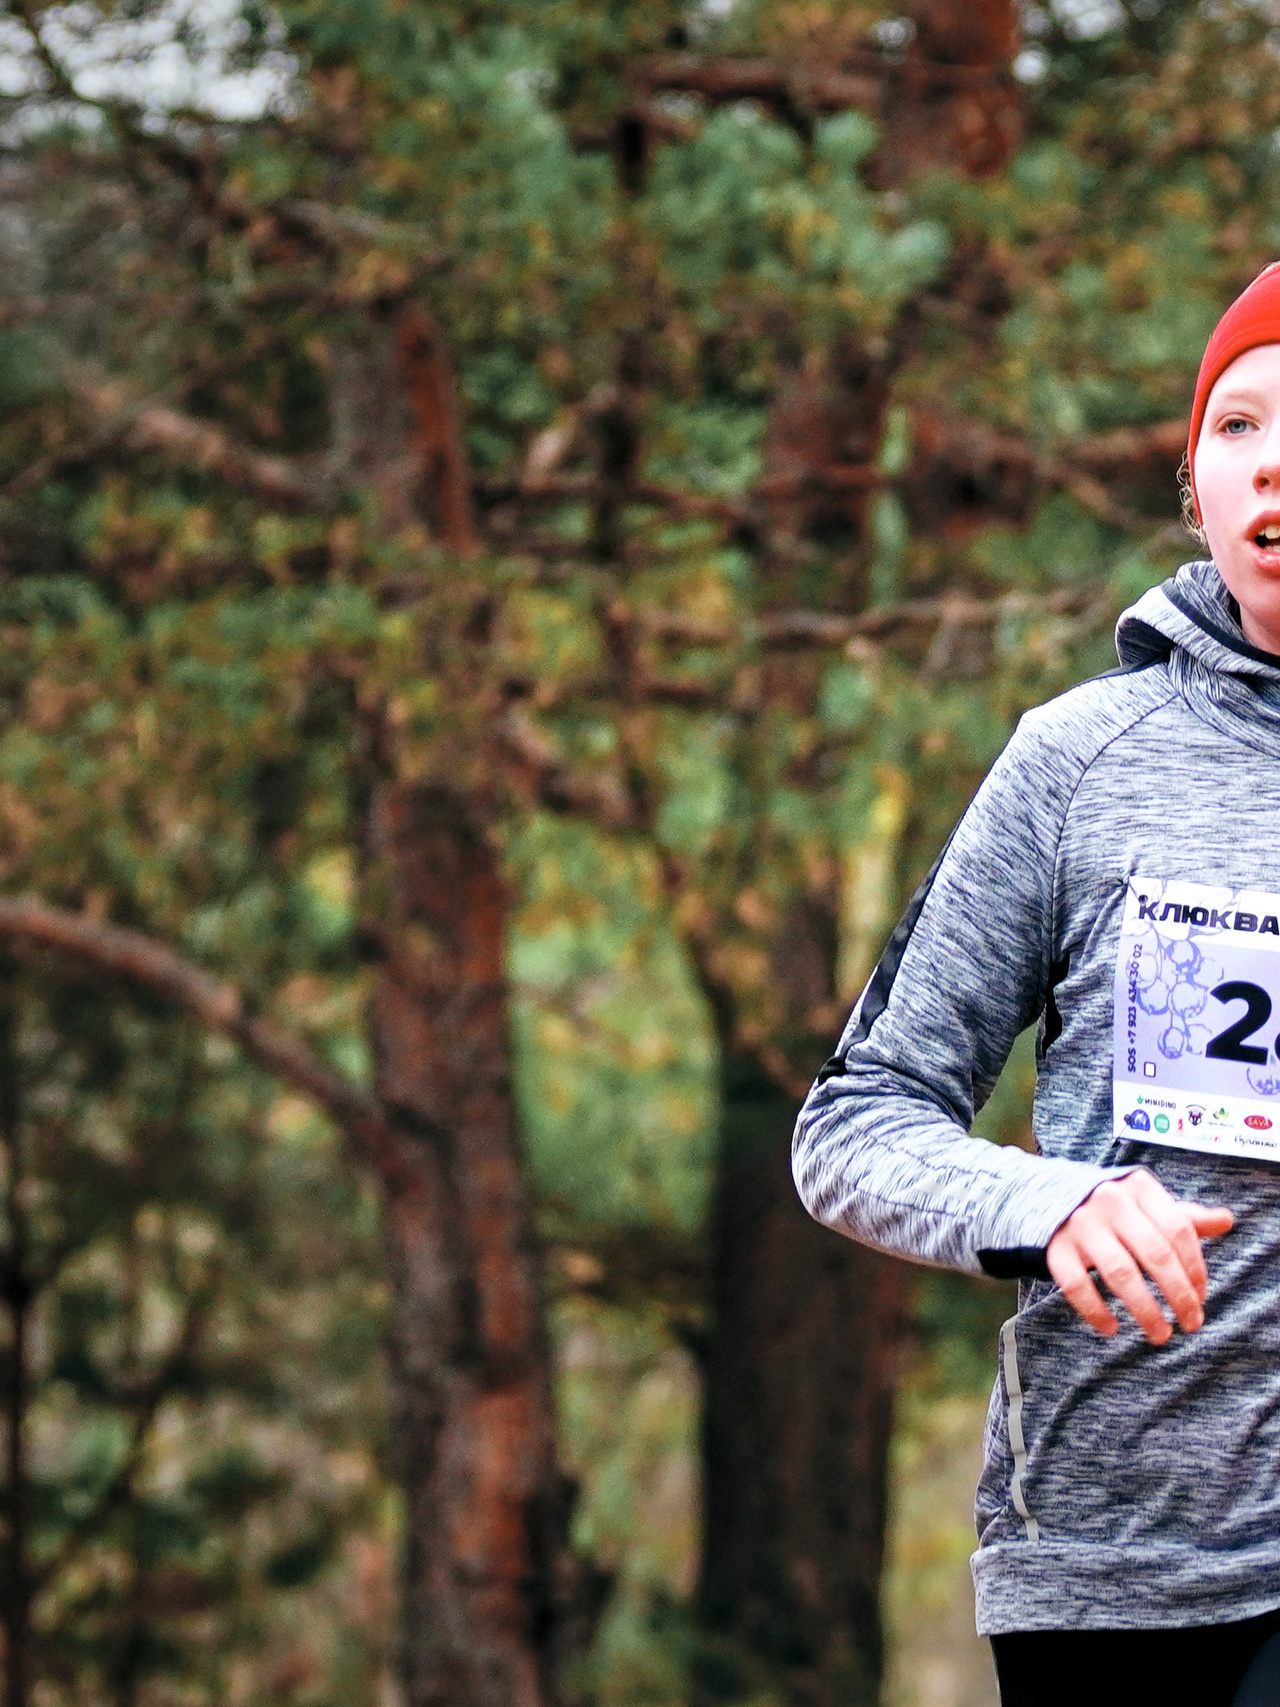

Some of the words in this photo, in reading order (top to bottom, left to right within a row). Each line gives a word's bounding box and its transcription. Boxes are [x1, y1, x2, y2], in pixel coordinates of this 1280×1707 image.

[1137, 902, 1280, 936] КЛЮКВА
[1132, 943, 1143, 959] 02
[1129, 961, 1140, 978] 30
[1127, 980, 1137, 1004] 434
[1127, 1006, 1137, 1028] 923
[1127, 1029, 1137, 1045] +7
[1127, 1047, 1137, 1073] SOS
[1144, 1098, 1177, 1110] MINIDINO
[1248, 1117, 1270, 1127] SAVA
